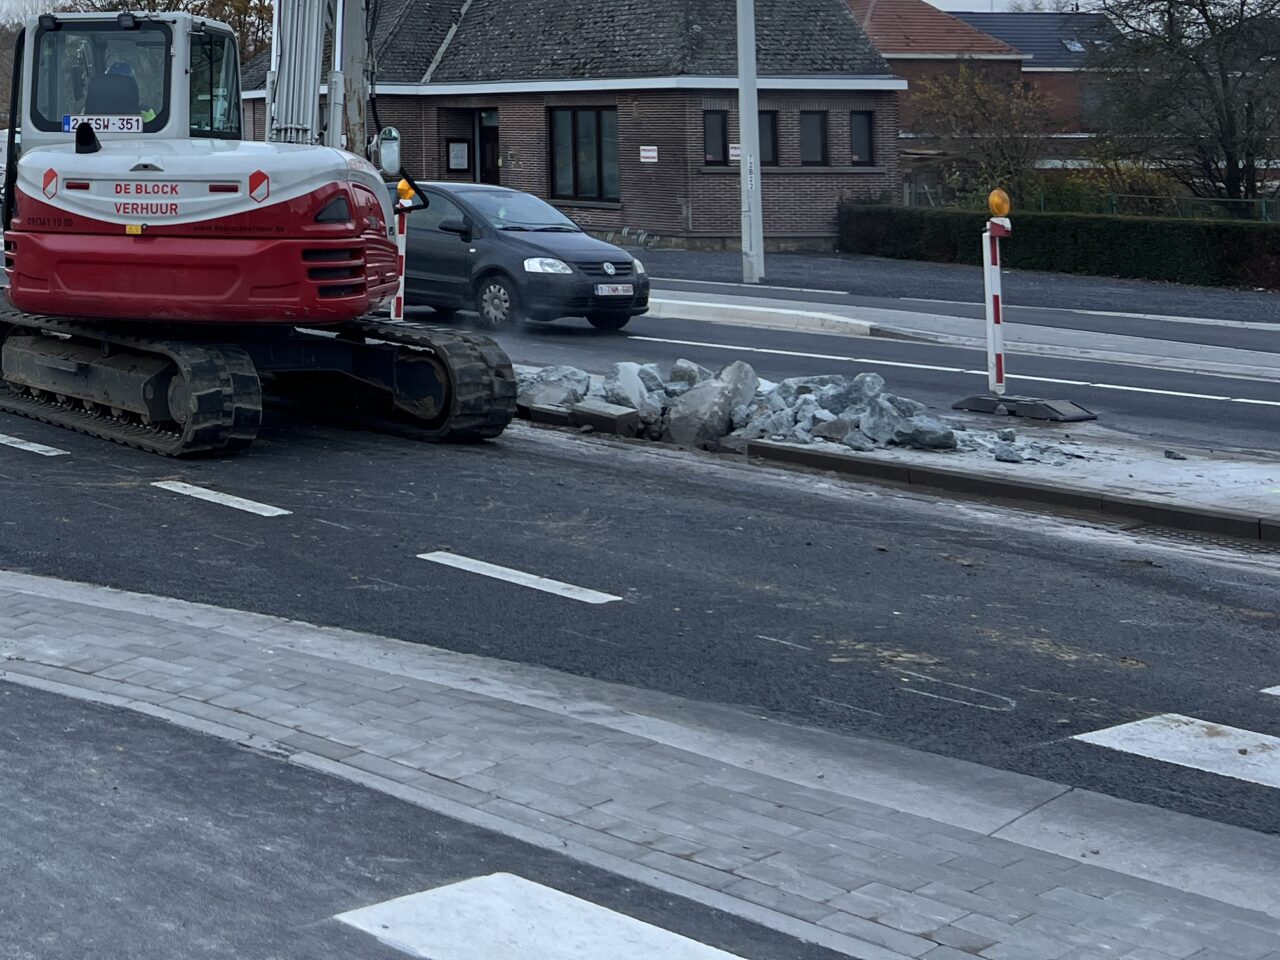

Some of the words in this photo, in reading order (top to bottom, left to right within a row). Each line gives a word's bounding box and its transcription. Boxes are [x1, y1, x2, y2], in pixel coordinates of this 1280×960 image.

[71, 117, 140, 130] 2ESW-351
[115, 184, 131, 194] DE
[135, 184, 179, 195] BLOCK
[114, 203, 179, 215] VERHUUR
